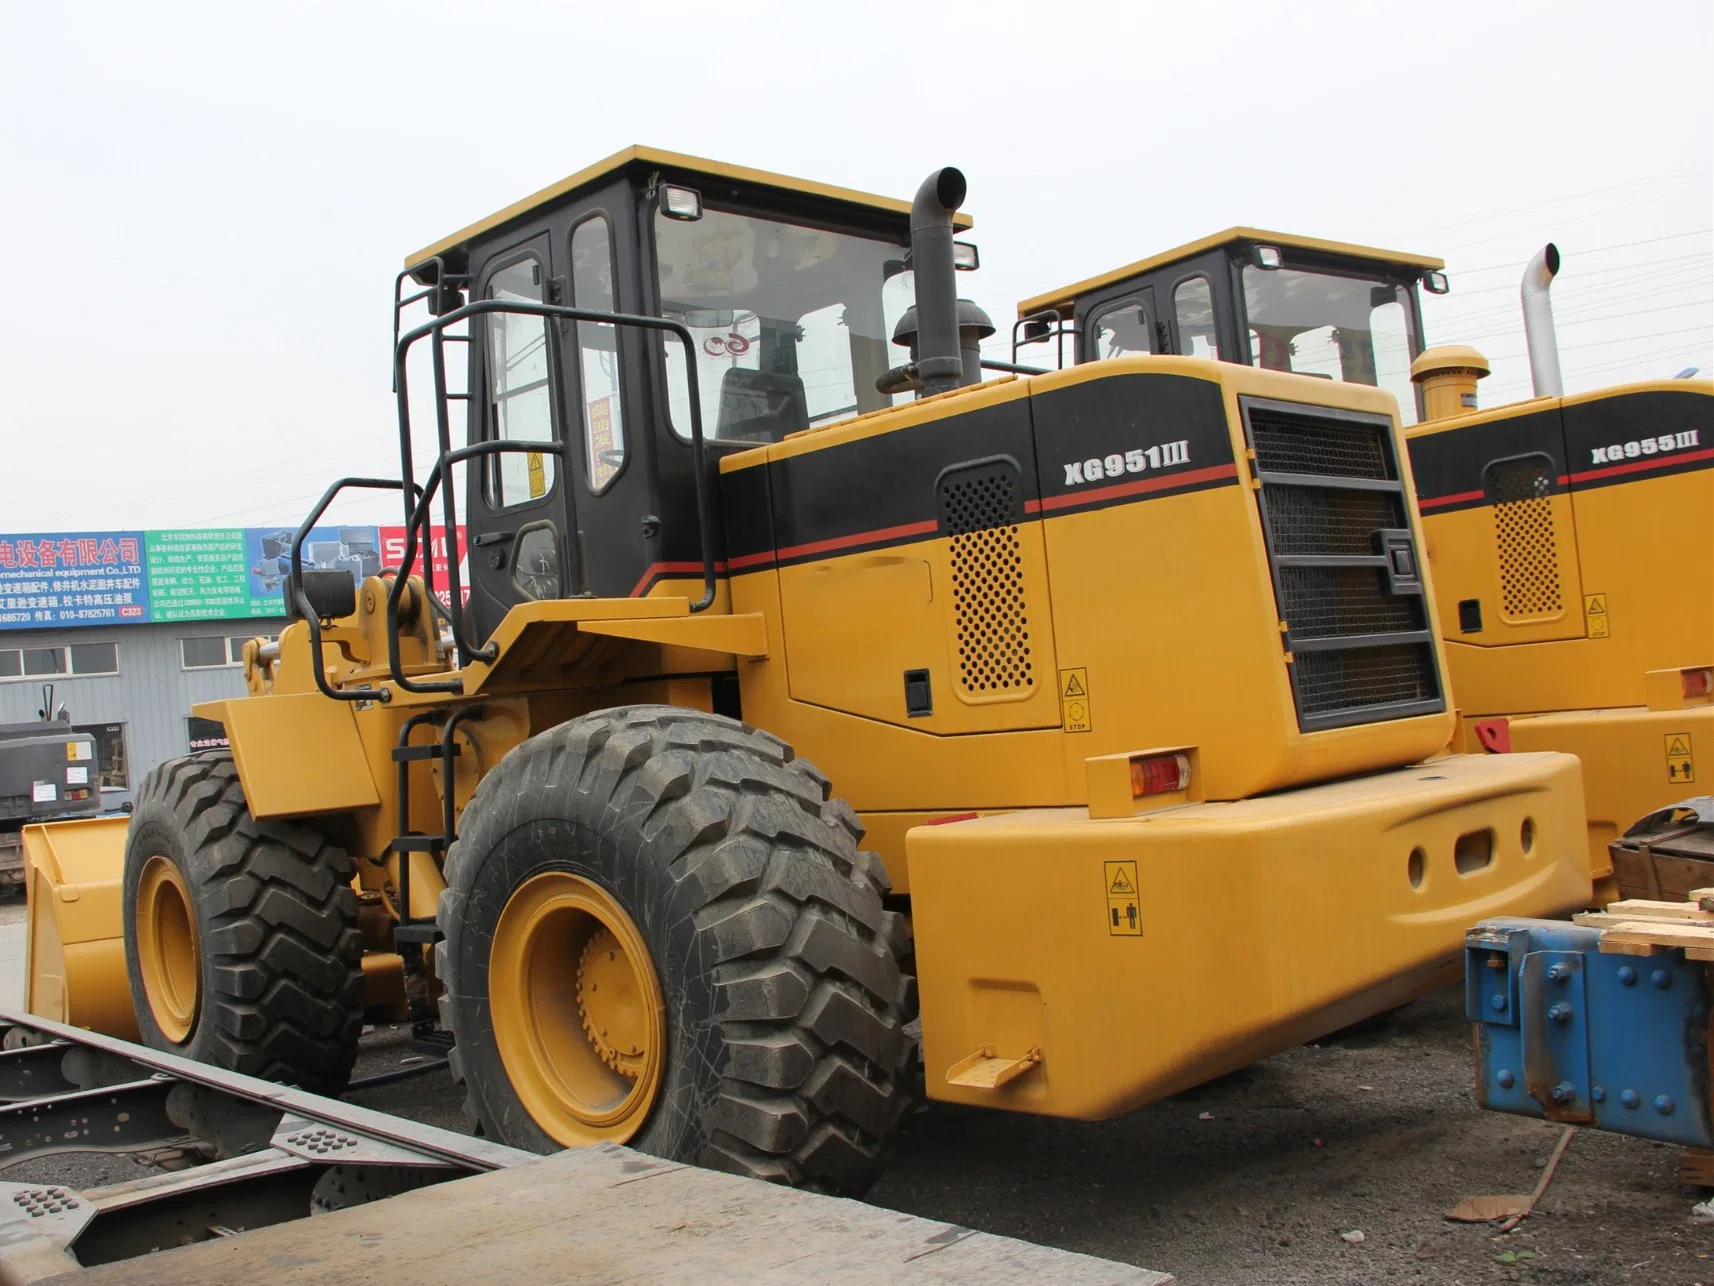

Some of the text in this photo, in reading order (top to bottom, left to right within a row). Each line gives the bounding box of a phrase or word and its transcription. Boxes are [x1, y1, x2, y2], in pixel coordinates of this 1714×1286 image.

[0, 537, 139, 569] 电设备有限公司
[55, 567, 105, 578] equipment
[121, 607, 142, 617] C323
[1069, 723, 1085, 731] STOP
